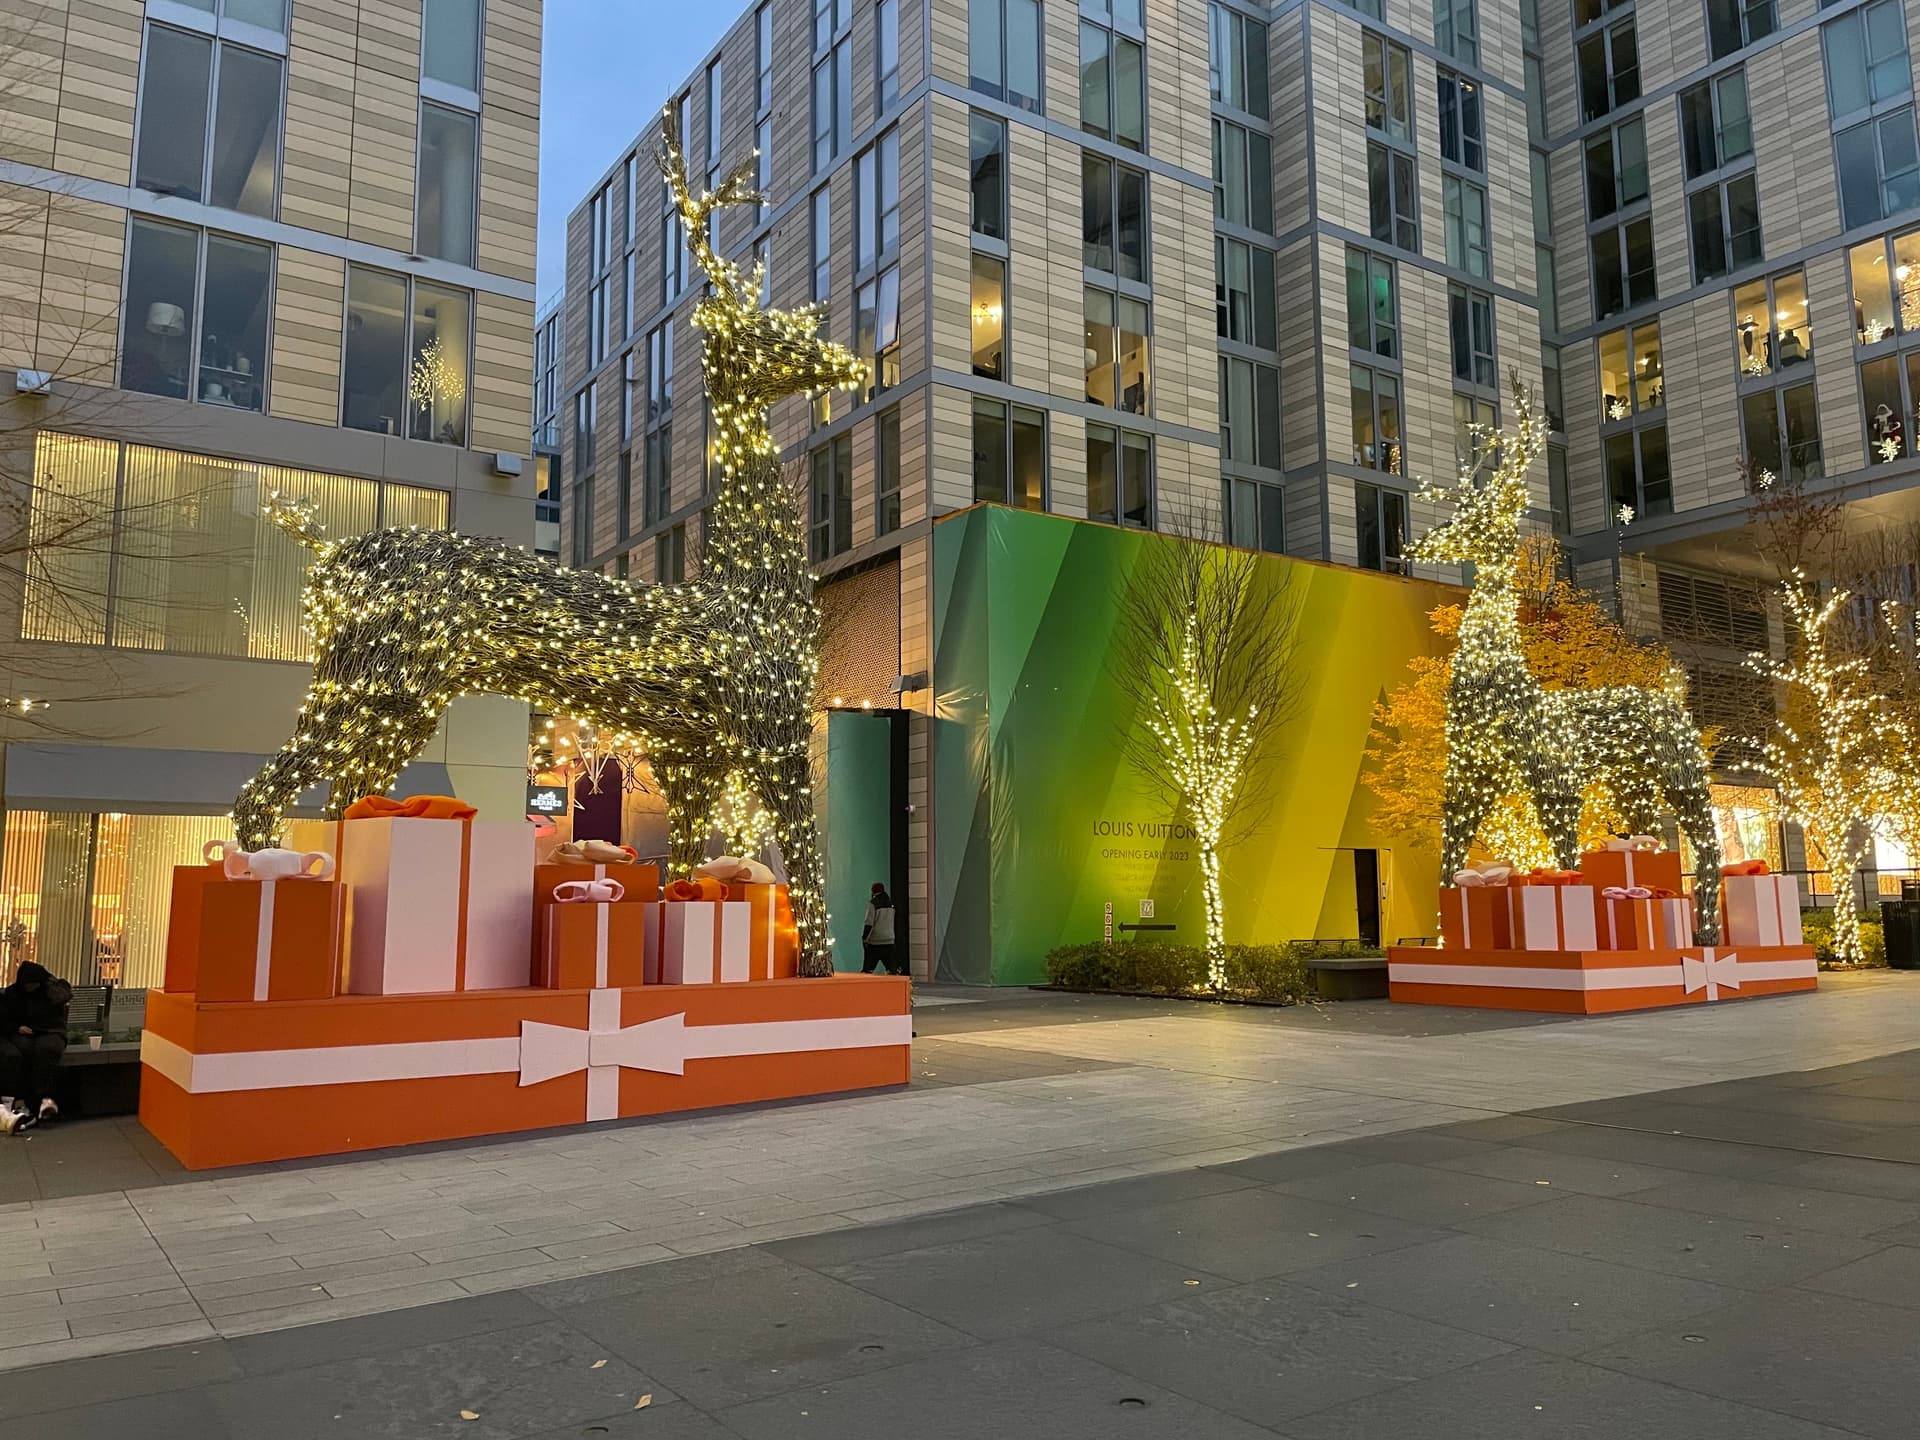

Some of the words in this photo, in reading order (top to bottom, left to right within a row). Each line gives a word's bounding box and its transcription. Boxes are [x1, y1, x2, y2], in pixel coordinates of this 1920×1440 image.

[1093, 820, 1134, 838] LOUIS
[1138, 823, 1197, 840] VUITTON
[1102, 849, 1142, 860] OPENING
[1144, 850, 1168, 861] EARLY
[1169, 851, 1190, 862] 2023
